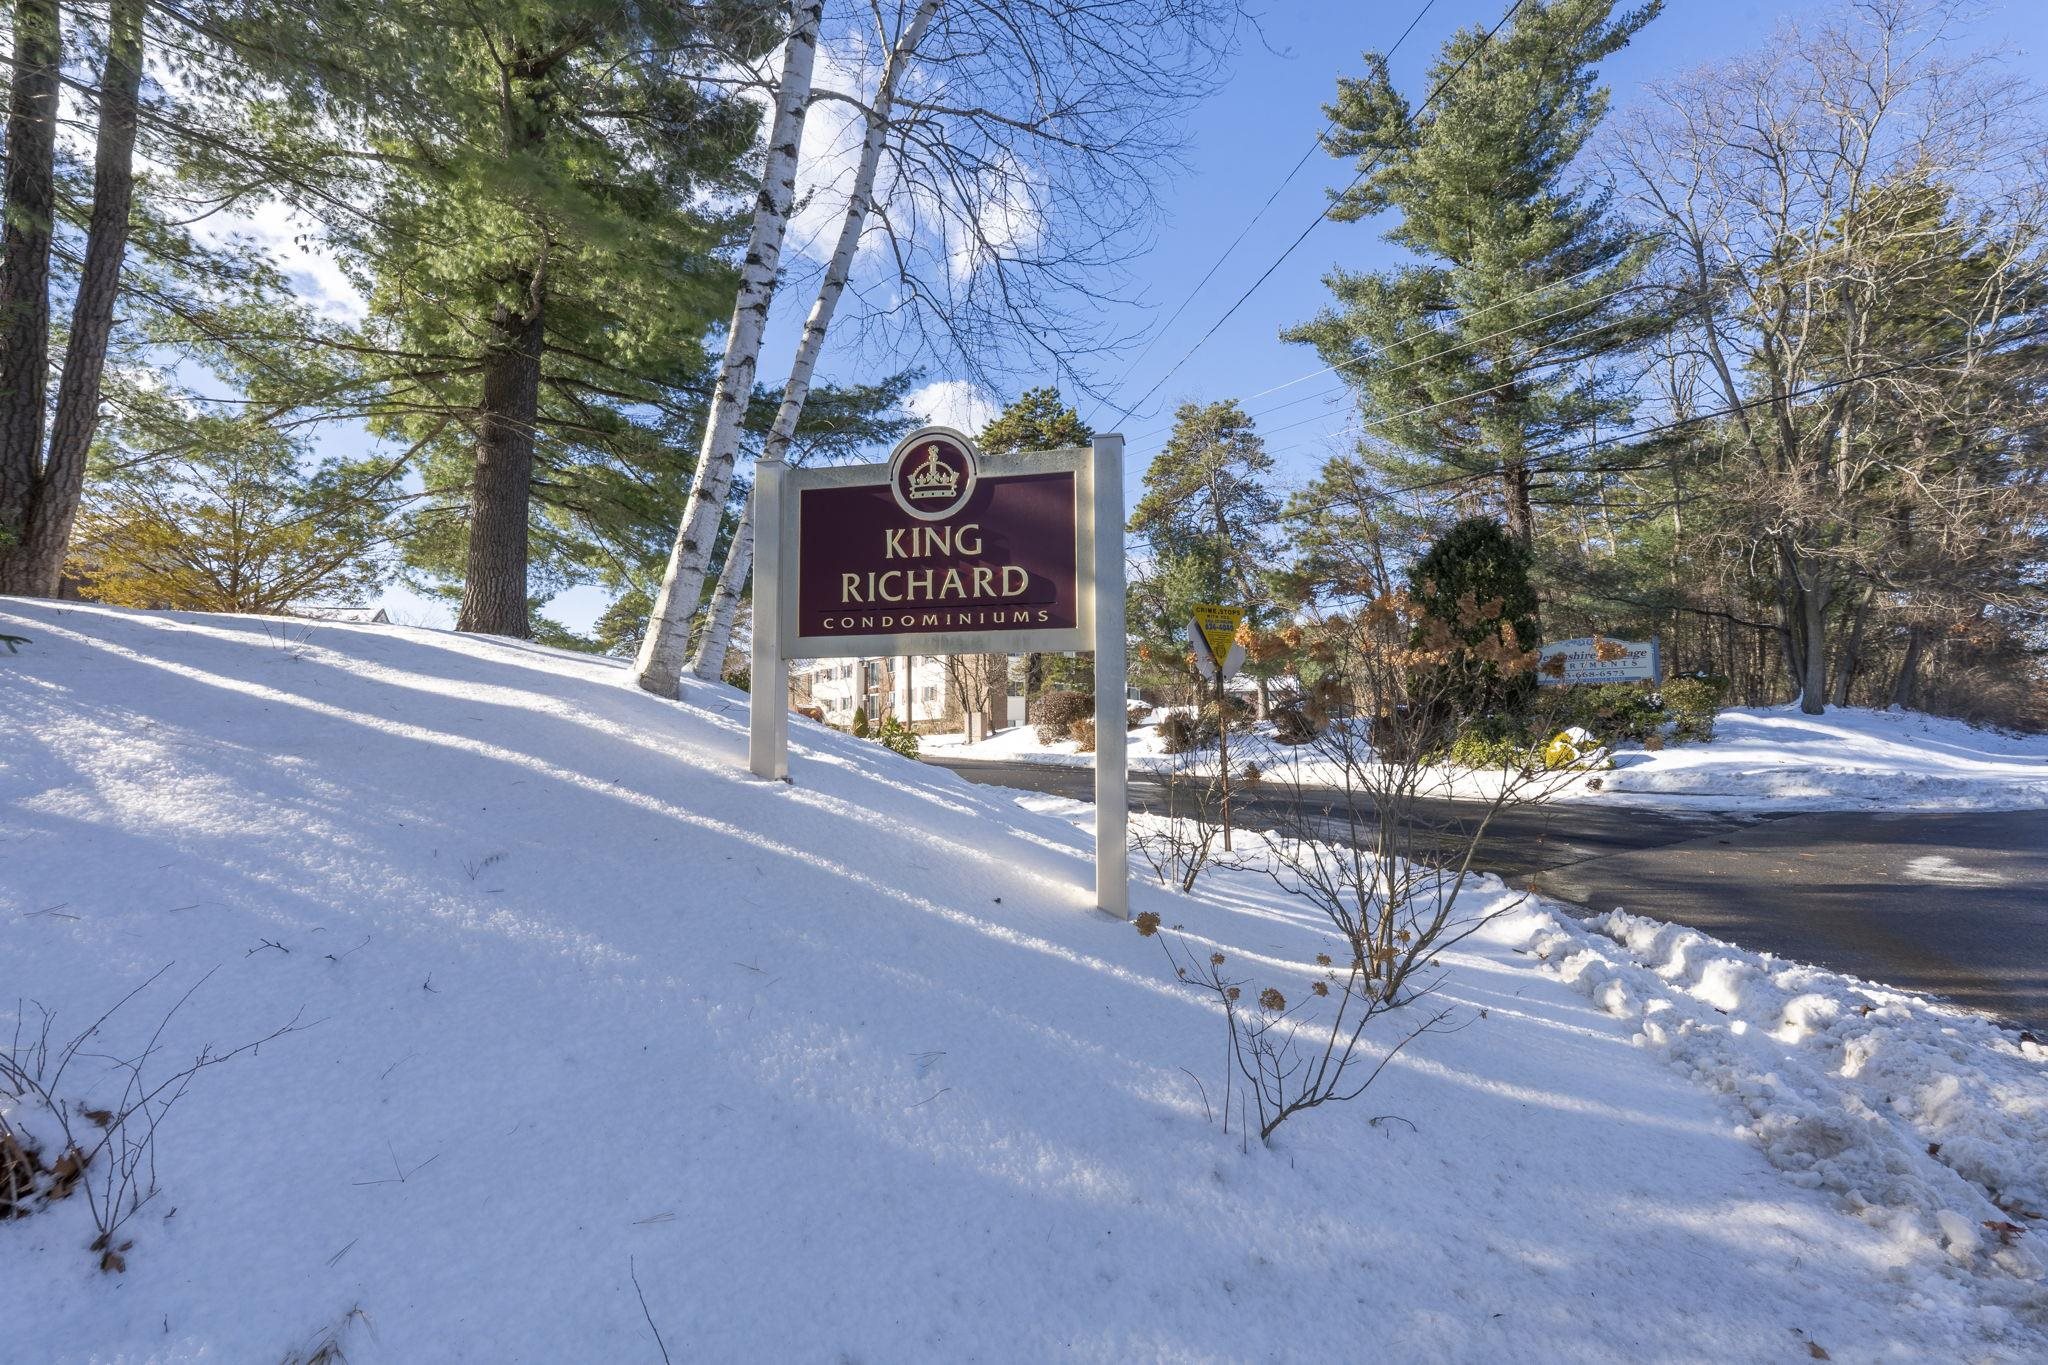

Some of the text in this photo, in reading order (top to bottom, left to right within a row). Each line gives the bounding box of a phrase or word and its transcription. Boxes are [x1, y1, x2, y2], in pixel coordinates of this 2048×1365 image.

[885, 523, 982, 559] KING
[841, 565, 1029, 603] RICHARD
[823, 610, 1049, 629] CONDOMINIUMS
